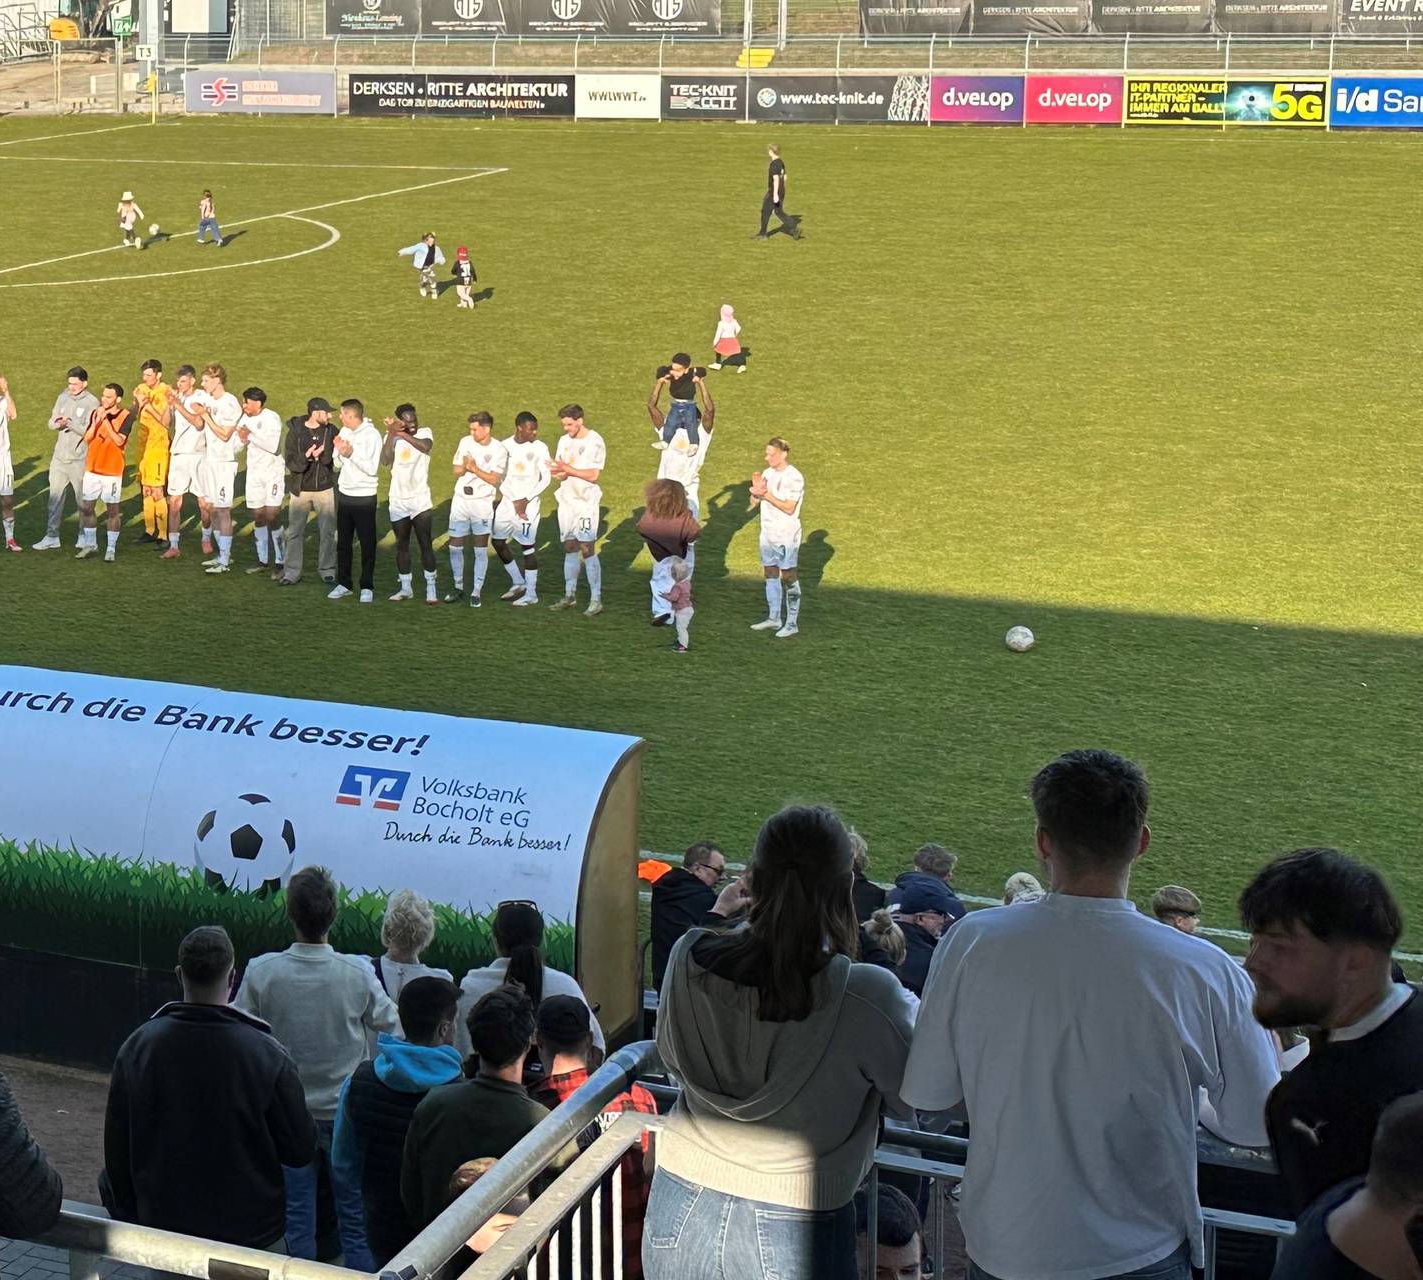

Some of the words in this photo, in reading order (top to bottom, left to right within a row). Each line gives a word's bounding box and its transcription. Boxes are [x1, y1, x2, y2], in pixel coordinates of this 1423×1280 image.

[1351, 0, 1409, 12] EVENT
[353, 82, 415, 95] DERKSEN
[427, 82, 464, 96] RITTE
[466, 83, 568, 97] ARCHITEKTUR
[1130, 83, 1151, 93] IHR
[1153, 83, 1227, 93] REGIONALER
[780, 91, 884, 105] www.tec-knit.de
[1130, 93, 1197, 103] IT-PARTNER
[1270, 83, 1323, 120] 5G
[1335, 86, 1379, 114] i/d
[1383, 89, 1423, 113] Sa
[1129, 102, 1169, 113] IMMER
[1171, 103, 1190, 113] AM
[522, 522, 532, 537] 17
[81, 696, 148, 723] die
[153, 704, 265, 737] Bank
[269, 717, 431, 756] besser!
[422, 776, 528, 805] Volksbank
[412, 796, 495, 824] Bocholt
[499, 810, 531, 828] eG
[383, 821, 433, 842] Durch
[438, 826, 461, 845] die
[467, 826, 515, 849] Bank
[518, 832, 572, 852] besser!
